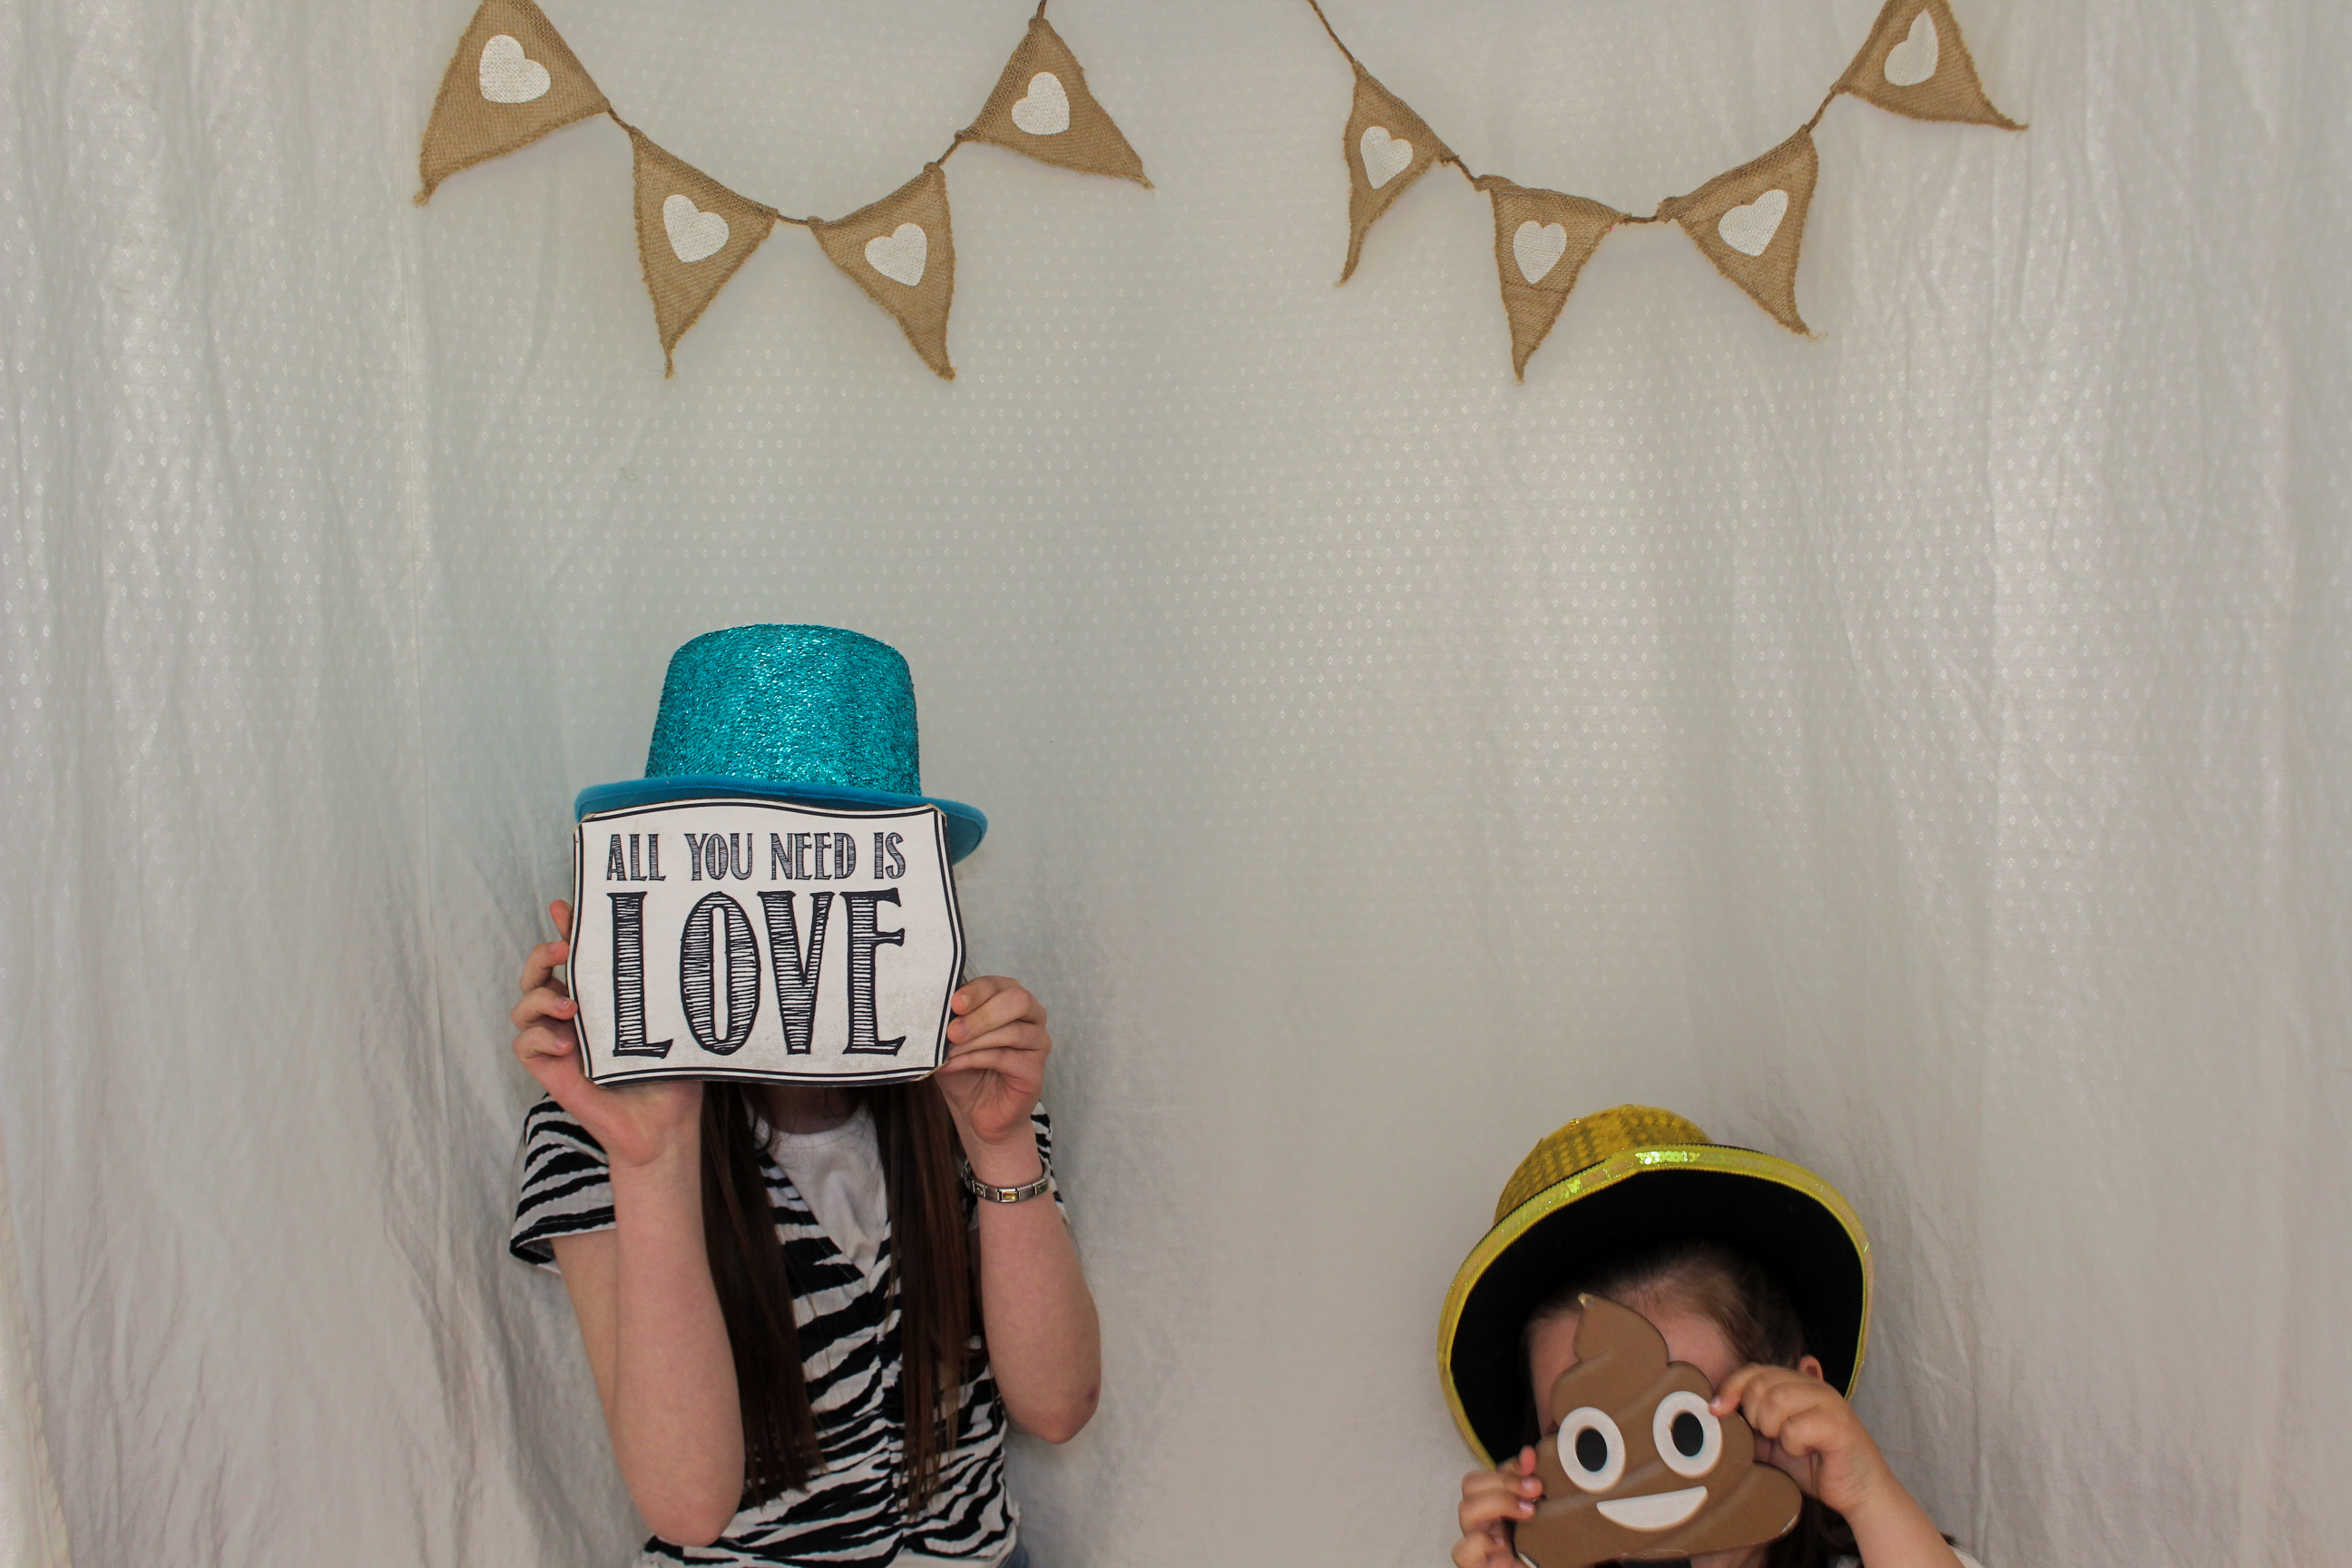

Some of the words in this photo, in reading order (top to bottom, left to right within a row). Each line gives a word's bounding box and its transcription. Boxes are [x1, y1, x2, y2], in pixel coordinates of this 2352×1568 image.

[606, 833, 666, 882] ALL
[684, 832, 753, 881] YOU
[769, 832, 857, 880] NEED
[873, 831, 906, 879] IS
[607, 887, 906, 1059] LOVE
